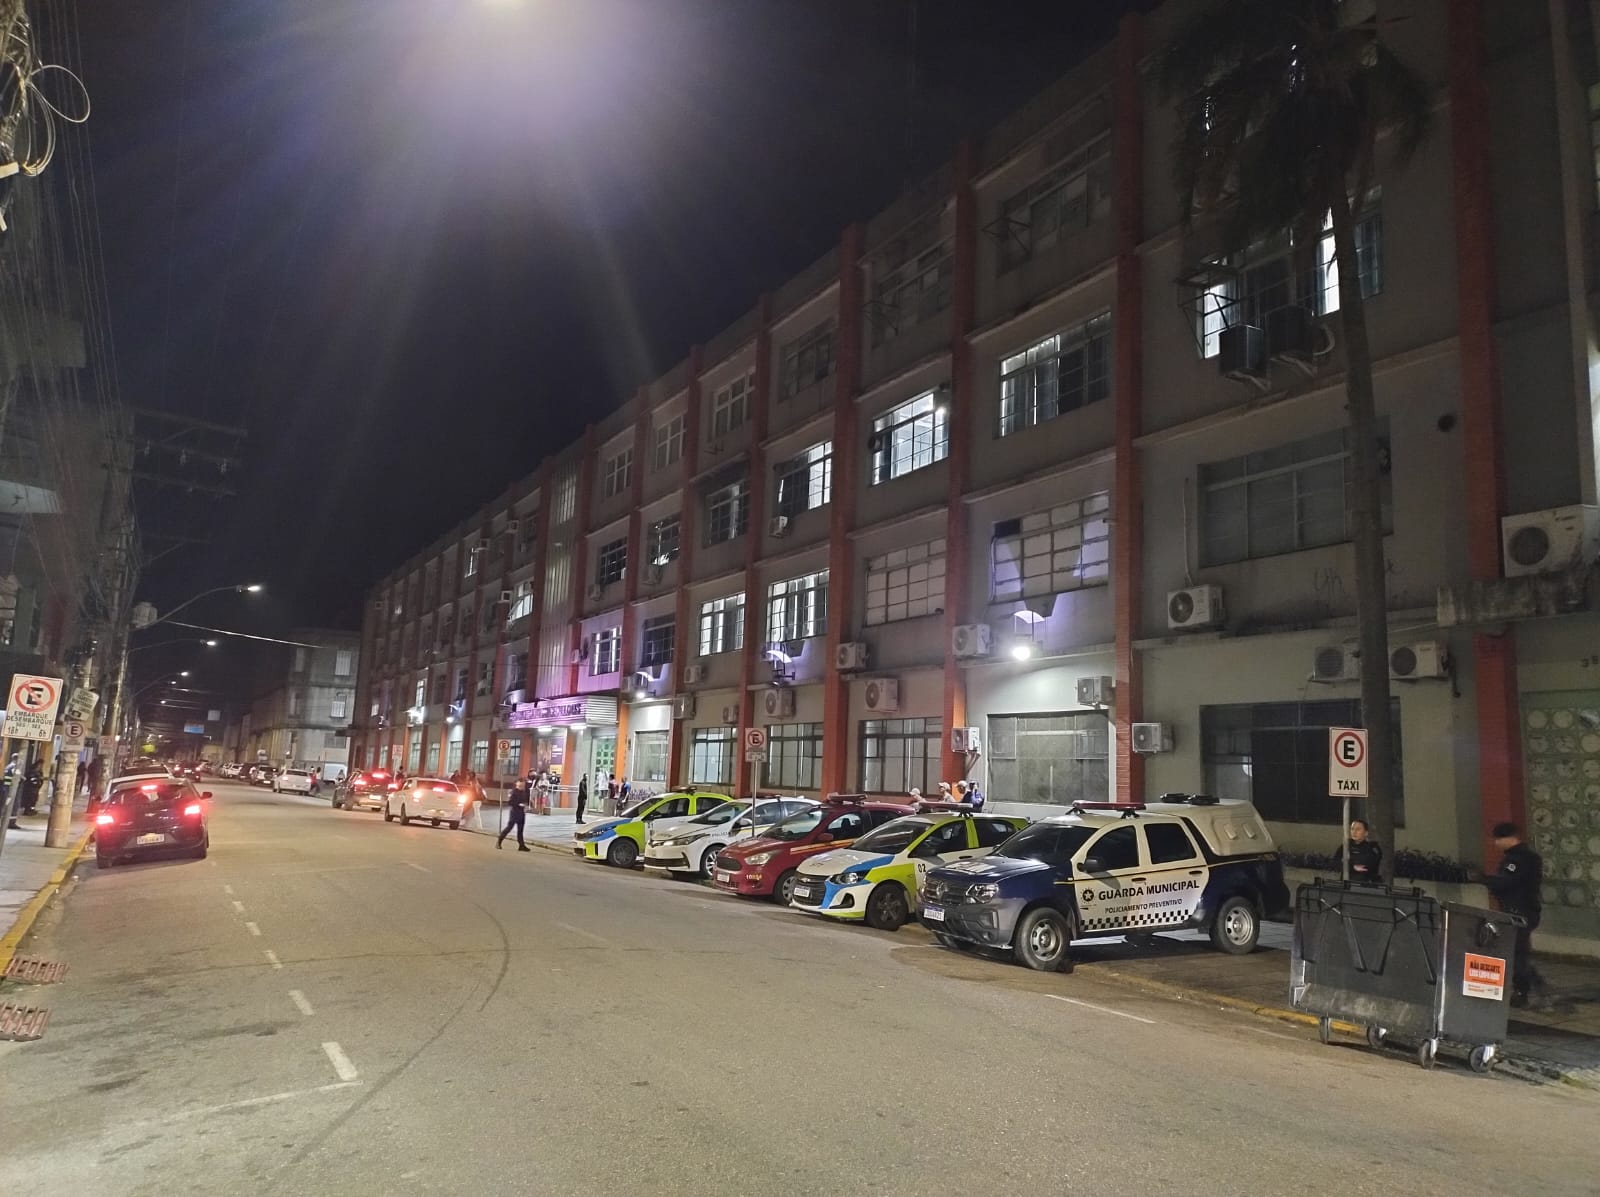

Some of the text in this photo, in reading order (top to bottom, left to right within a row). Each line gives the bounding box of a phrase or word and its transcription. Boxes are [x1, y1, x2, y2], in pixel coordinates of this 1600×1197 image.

[6, 715, 53, 726] DESEMBARQUE
[14, 711, 49, 719] EMBARQUE
[70, 726, 78, 736] E
[1343, 740, 1355, 760] E
[917, 863, 927, 873] 02
[1098, 880, 1200, 900] GUARDA MUNICIPAL
[1105, 903, 1148, 914] POLICIAMENTO
[1148, 898, 1183, 909] PREVENTIVO
